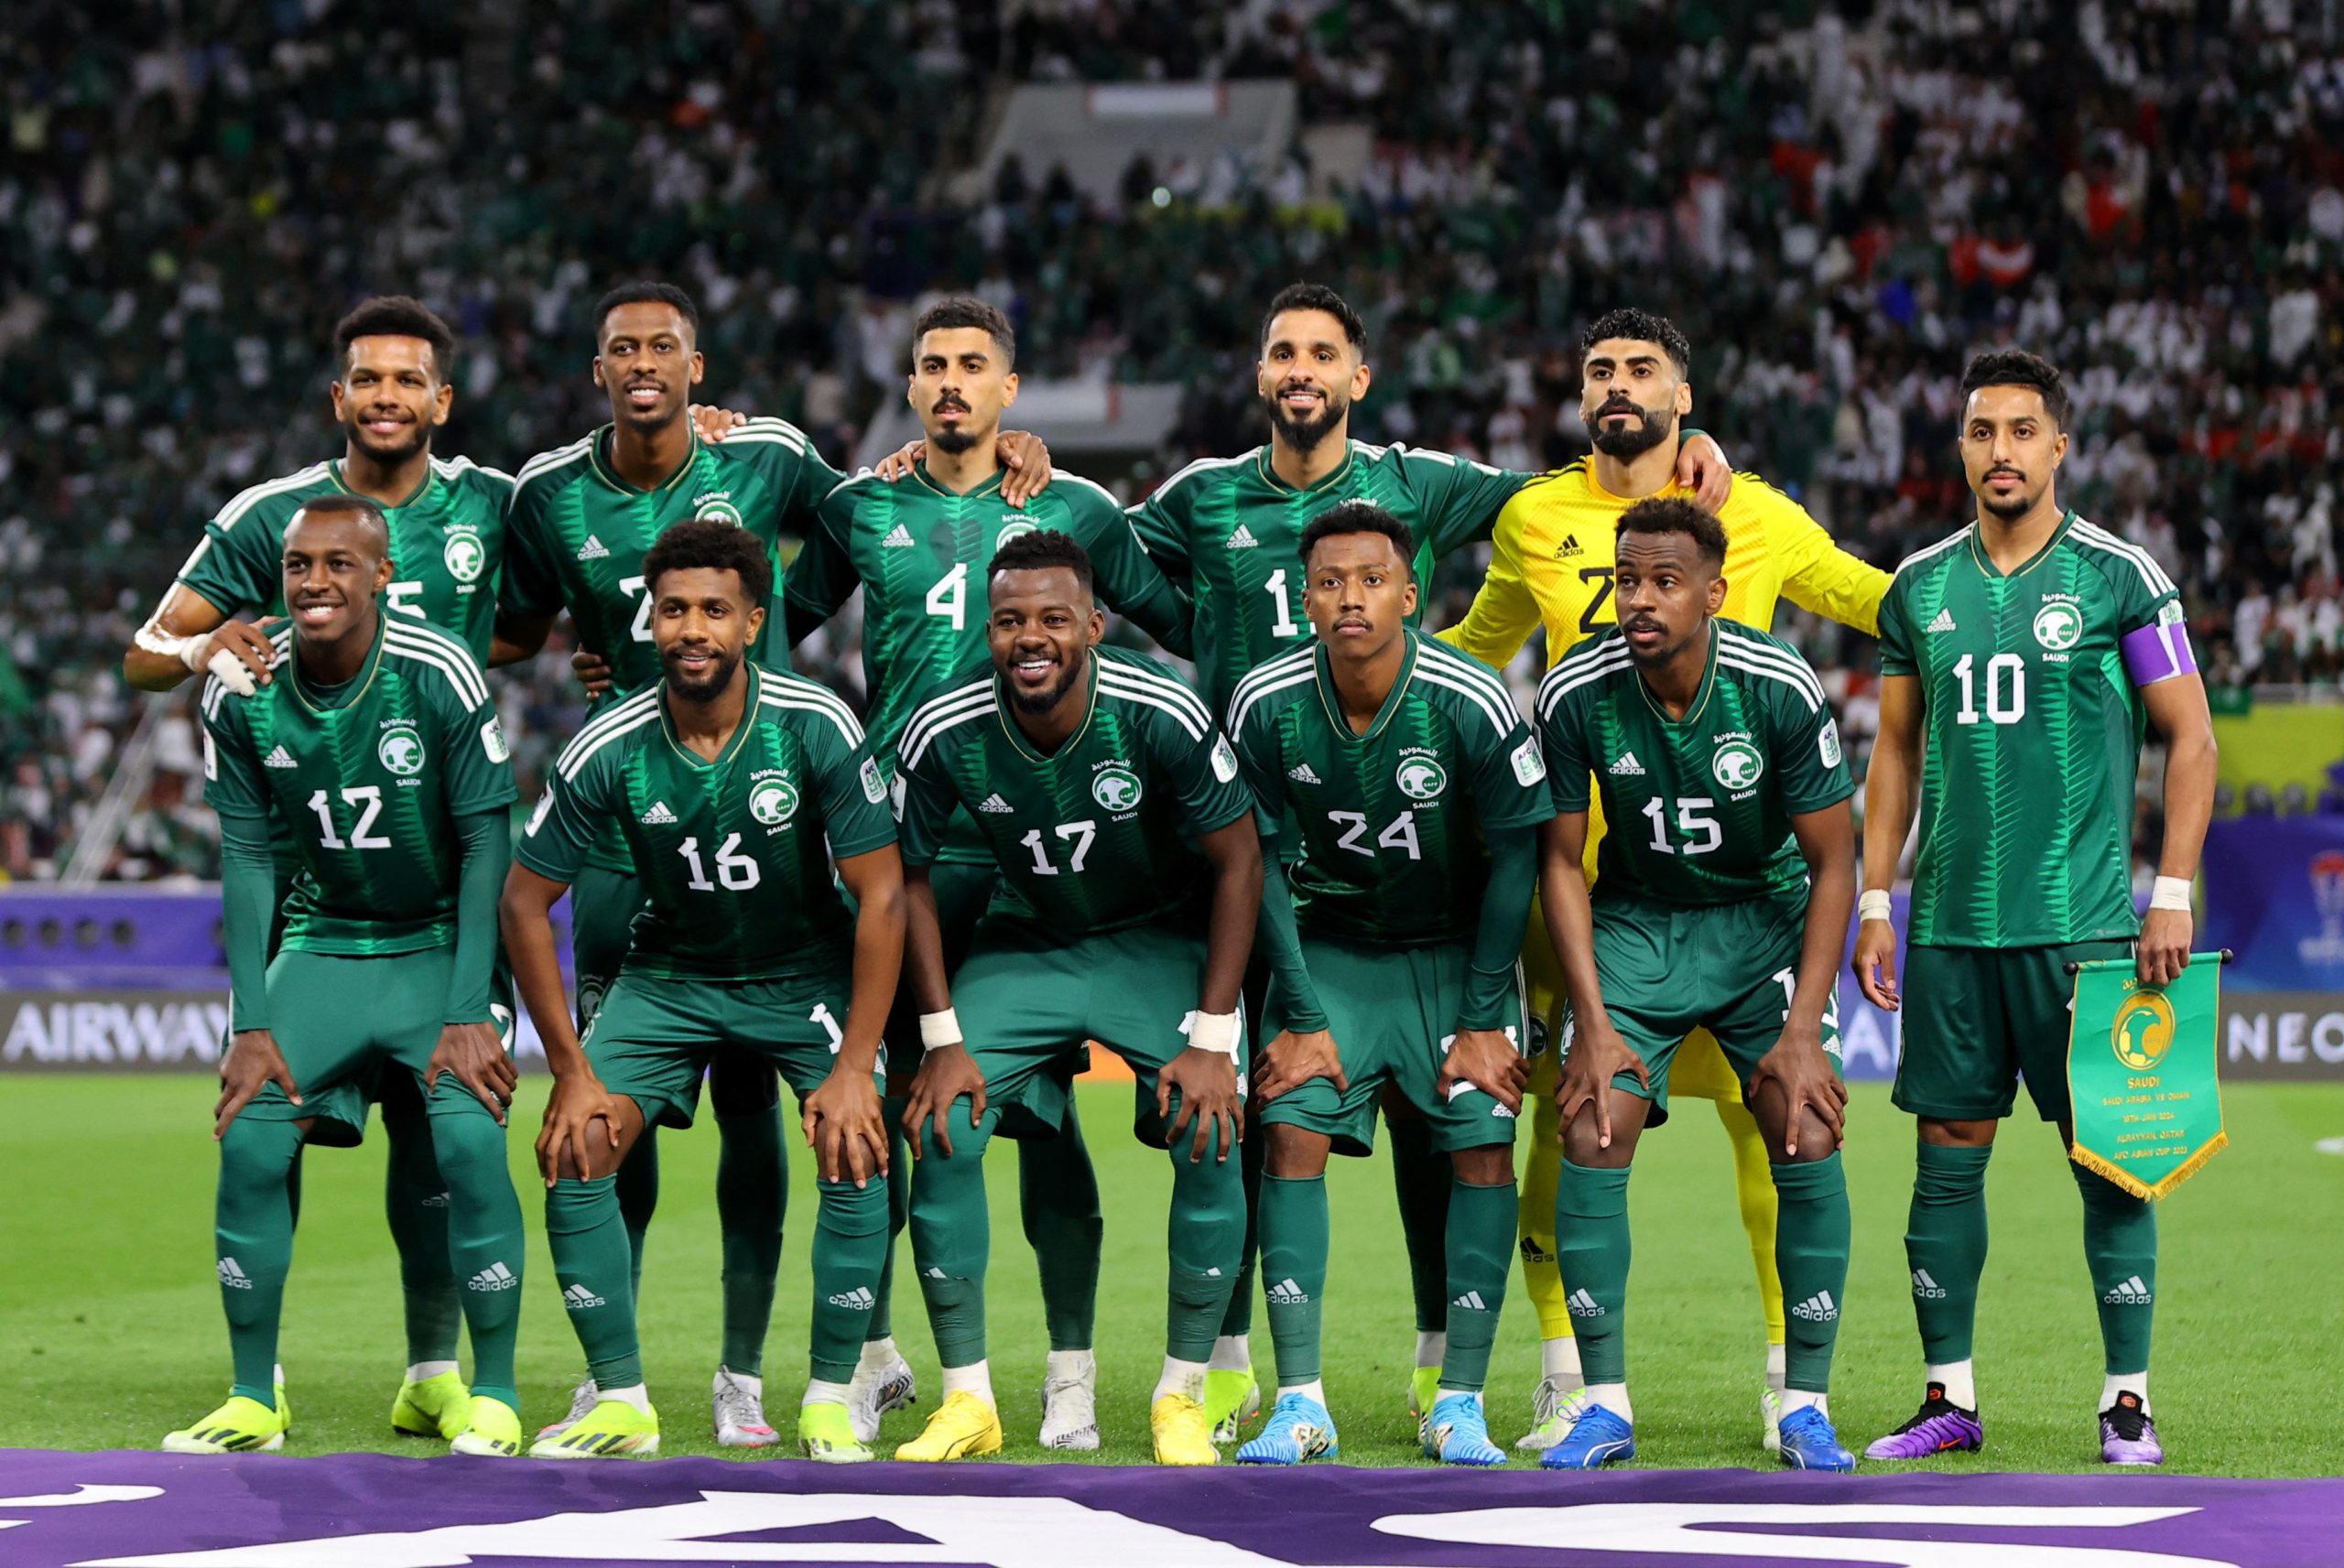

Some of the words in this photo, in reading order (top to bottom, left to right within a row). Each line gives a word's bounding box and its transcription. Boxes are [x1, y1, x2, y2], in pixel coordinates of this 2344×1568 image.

[882, 538, 915, 547] adidas
[1226, 538, 1258, 549] adidas
[578, 548, 610, 560] adidas
[1554, 547, 1584, 559] adidas
[926, 563, 967, 631] 4
[1264, 568, 1315, 637] 1
[1579, 567, 1619, 633] 2
[2041, 593, 2081, 603] السعودية
[619, 575, 655, 642] 2
[1926, 622, 1957, 633] adidas
[2042, 653, 2070, 663] SAUDI
[1952, 654, 2025, 724] 10
[1713, 731, 1753, 744] السعودية
[1398, 747, 1438, 757] السعودية
[264, 759, 298, 768] adidas
[1091, 759, 1131, 772] السعودية
[1609, 765, 1645, 775] adidas
[750, 768, 788, 781] السعودية
[1288, 771, 1321, 784] adidas
[396, 779, 421, 787] SAUDI
[1731, 788, 1757, 802] SAUDI
[979, 805, 1014, 814] adidas
[1413, 801, 1438, 810] SAUDI
[307, 785, 392, 849] 12
[641, 815, 678, 824] adidas
[1112, 811, 1138, 823] SAUDI
[766, 822, 792, 837] SAUDI
[1642, 796, 1722, 855] 15
[1328, 810, 1421, 860] 24
[1020, 819, 1096, 875] 17
[677, 832, 761, 892] 16
[2127, 1076, 2160, 1089] SAUDI
[1524, 1253, 1555, 1263] das
[219, 1274, 253, 1289] das
[468, 1276, 517, 1292] adidas
[1915, 1285, 1947, 1298] das
[2103, 1292, 2152, 1304] adidas
[566, 1296, 605, 1309] das
[1792, 1307, 1839, 1322] adidas
